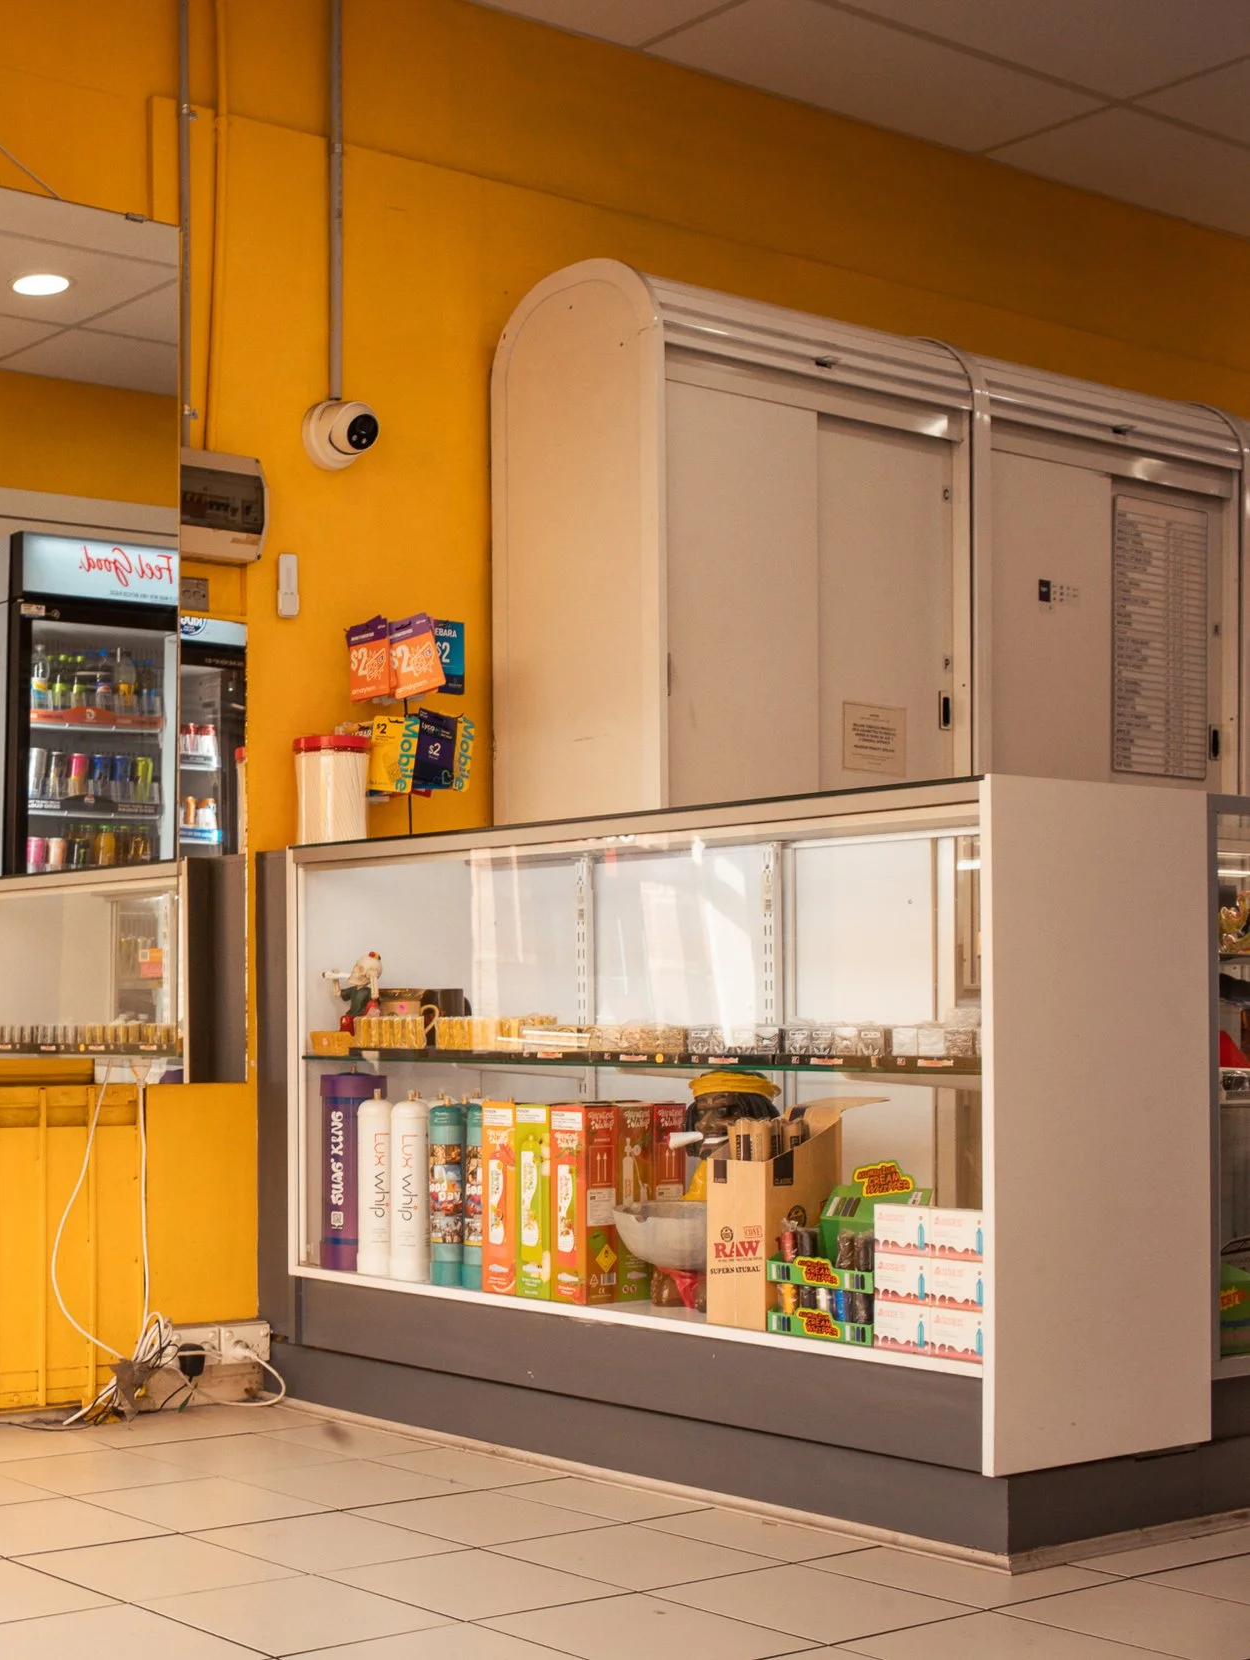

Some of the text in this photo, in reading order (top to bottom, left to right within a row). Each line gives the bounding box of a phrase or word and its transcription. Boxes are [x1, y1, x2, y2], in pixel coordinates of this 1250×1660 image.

[350, 647, 369, 677] $2
[390, 645, 413, 674] $2
[376, 722, 387, 734] $2
[394, 716, 421, 792] Mobile
[427, 742, 442, 757] $2
[452, 715, 475, 792] Mobile
[369, 1132, 391, 1219] Lux whip
[397, 1134, 419, 1222] Lux whip
[868, 1172, 900, 1187] CREAM
[865, 1180, 911, 1195] WHIPPER
[713, 1239, 761, 1259] RAW
[805, 1272, 838, 1285] WHIPPER
[806, 1266, 831, 1276] CREAM
[805, 1324, 839, 1337] WHIPPER
[807, 1318, 832, 1328] CREAM
